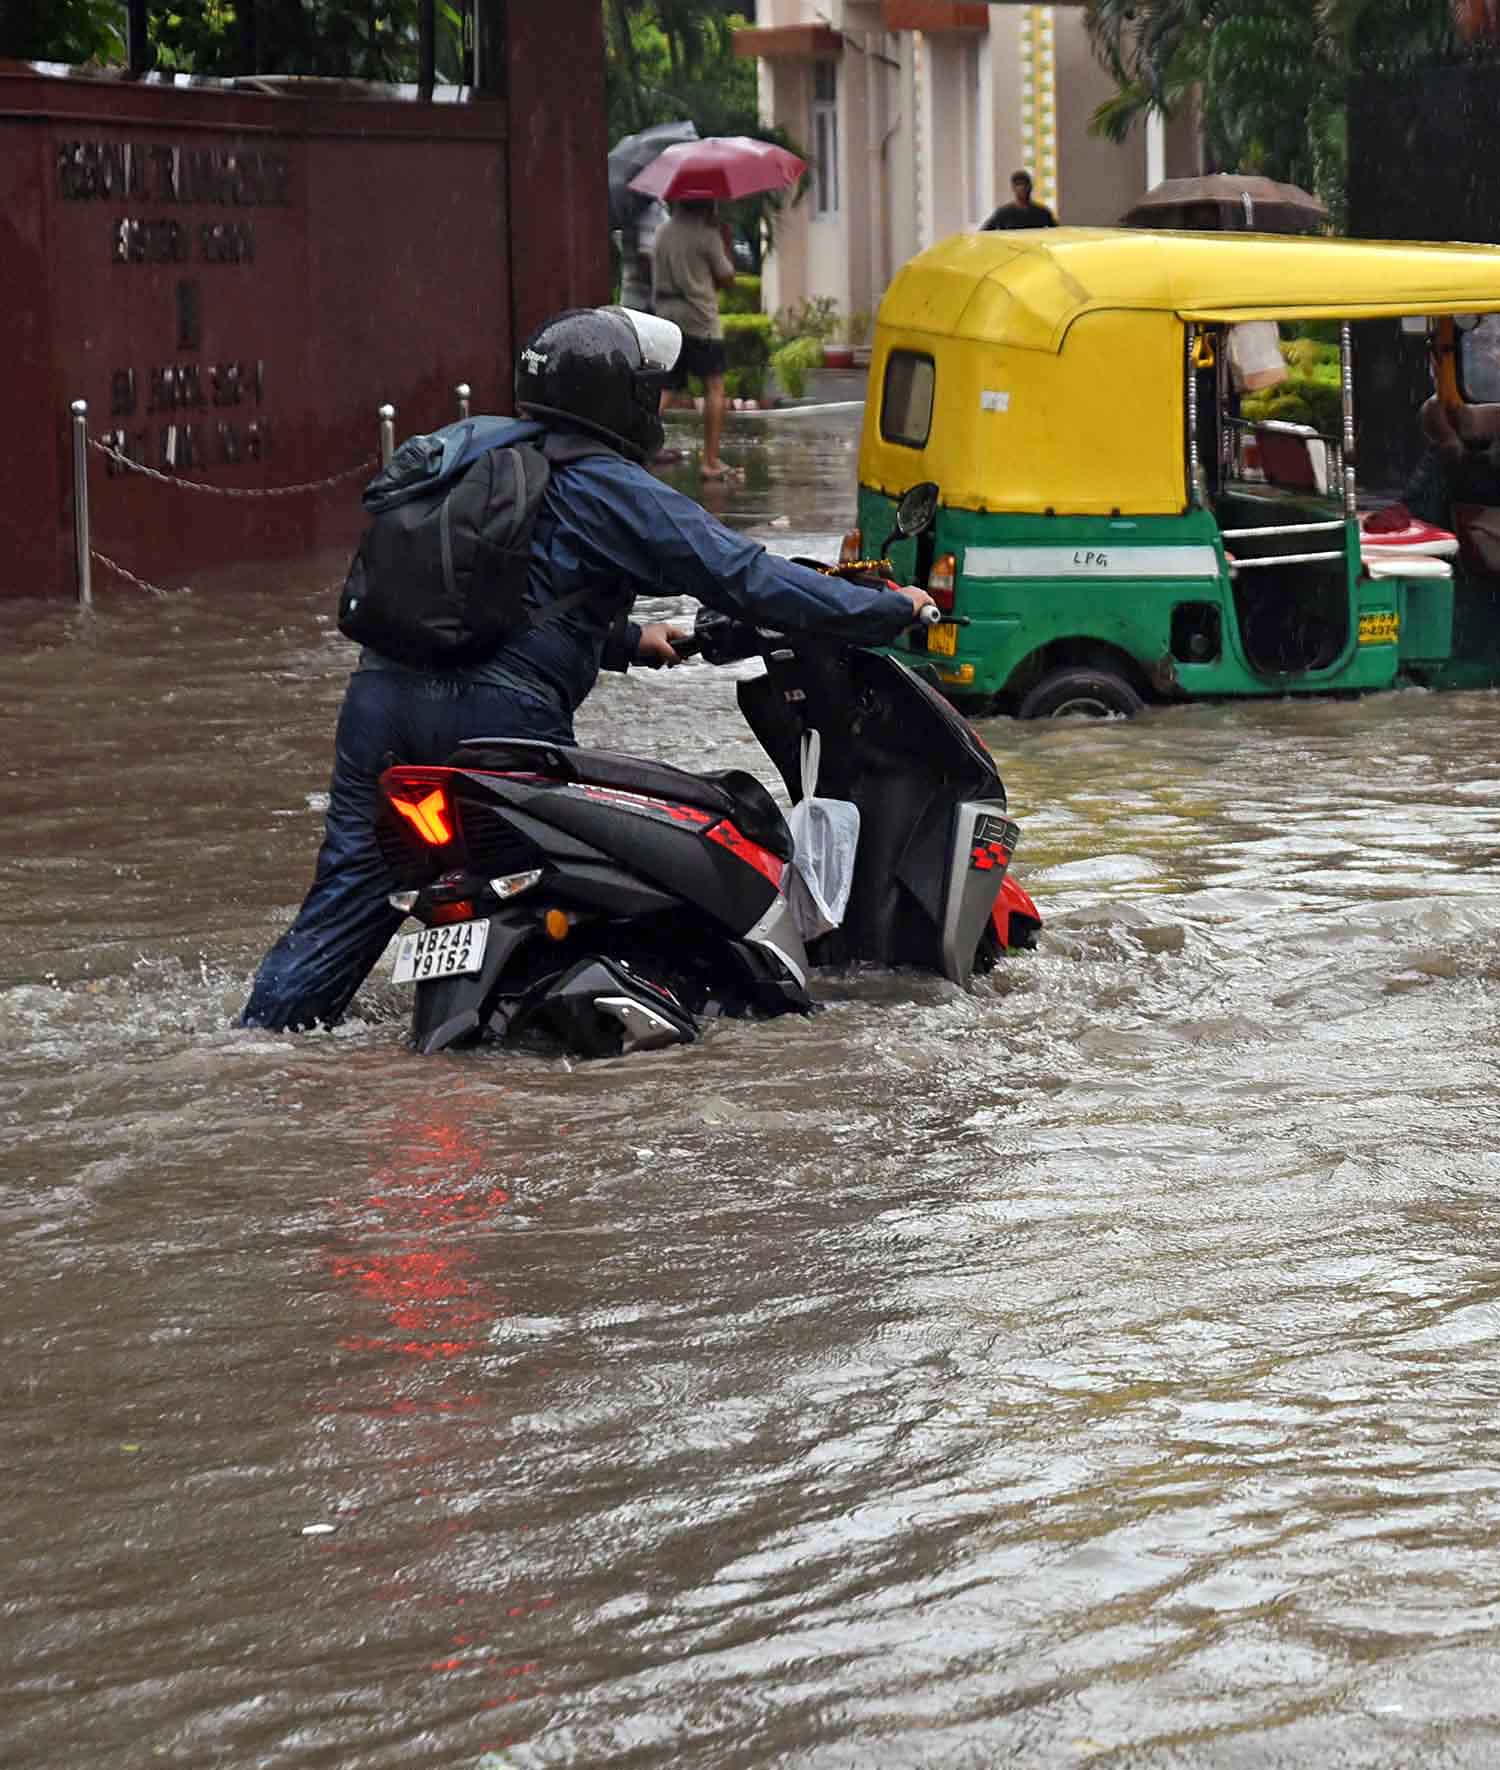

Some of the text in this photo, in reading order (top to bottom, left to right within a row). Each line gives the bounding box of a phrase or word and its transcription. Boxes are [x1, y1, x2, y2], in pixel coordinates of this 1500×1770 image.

[1073, 551, 1107, 567] LPG
[415, 924, 473, 956] WB24A
[412, 948, 470, 978] Y9152
